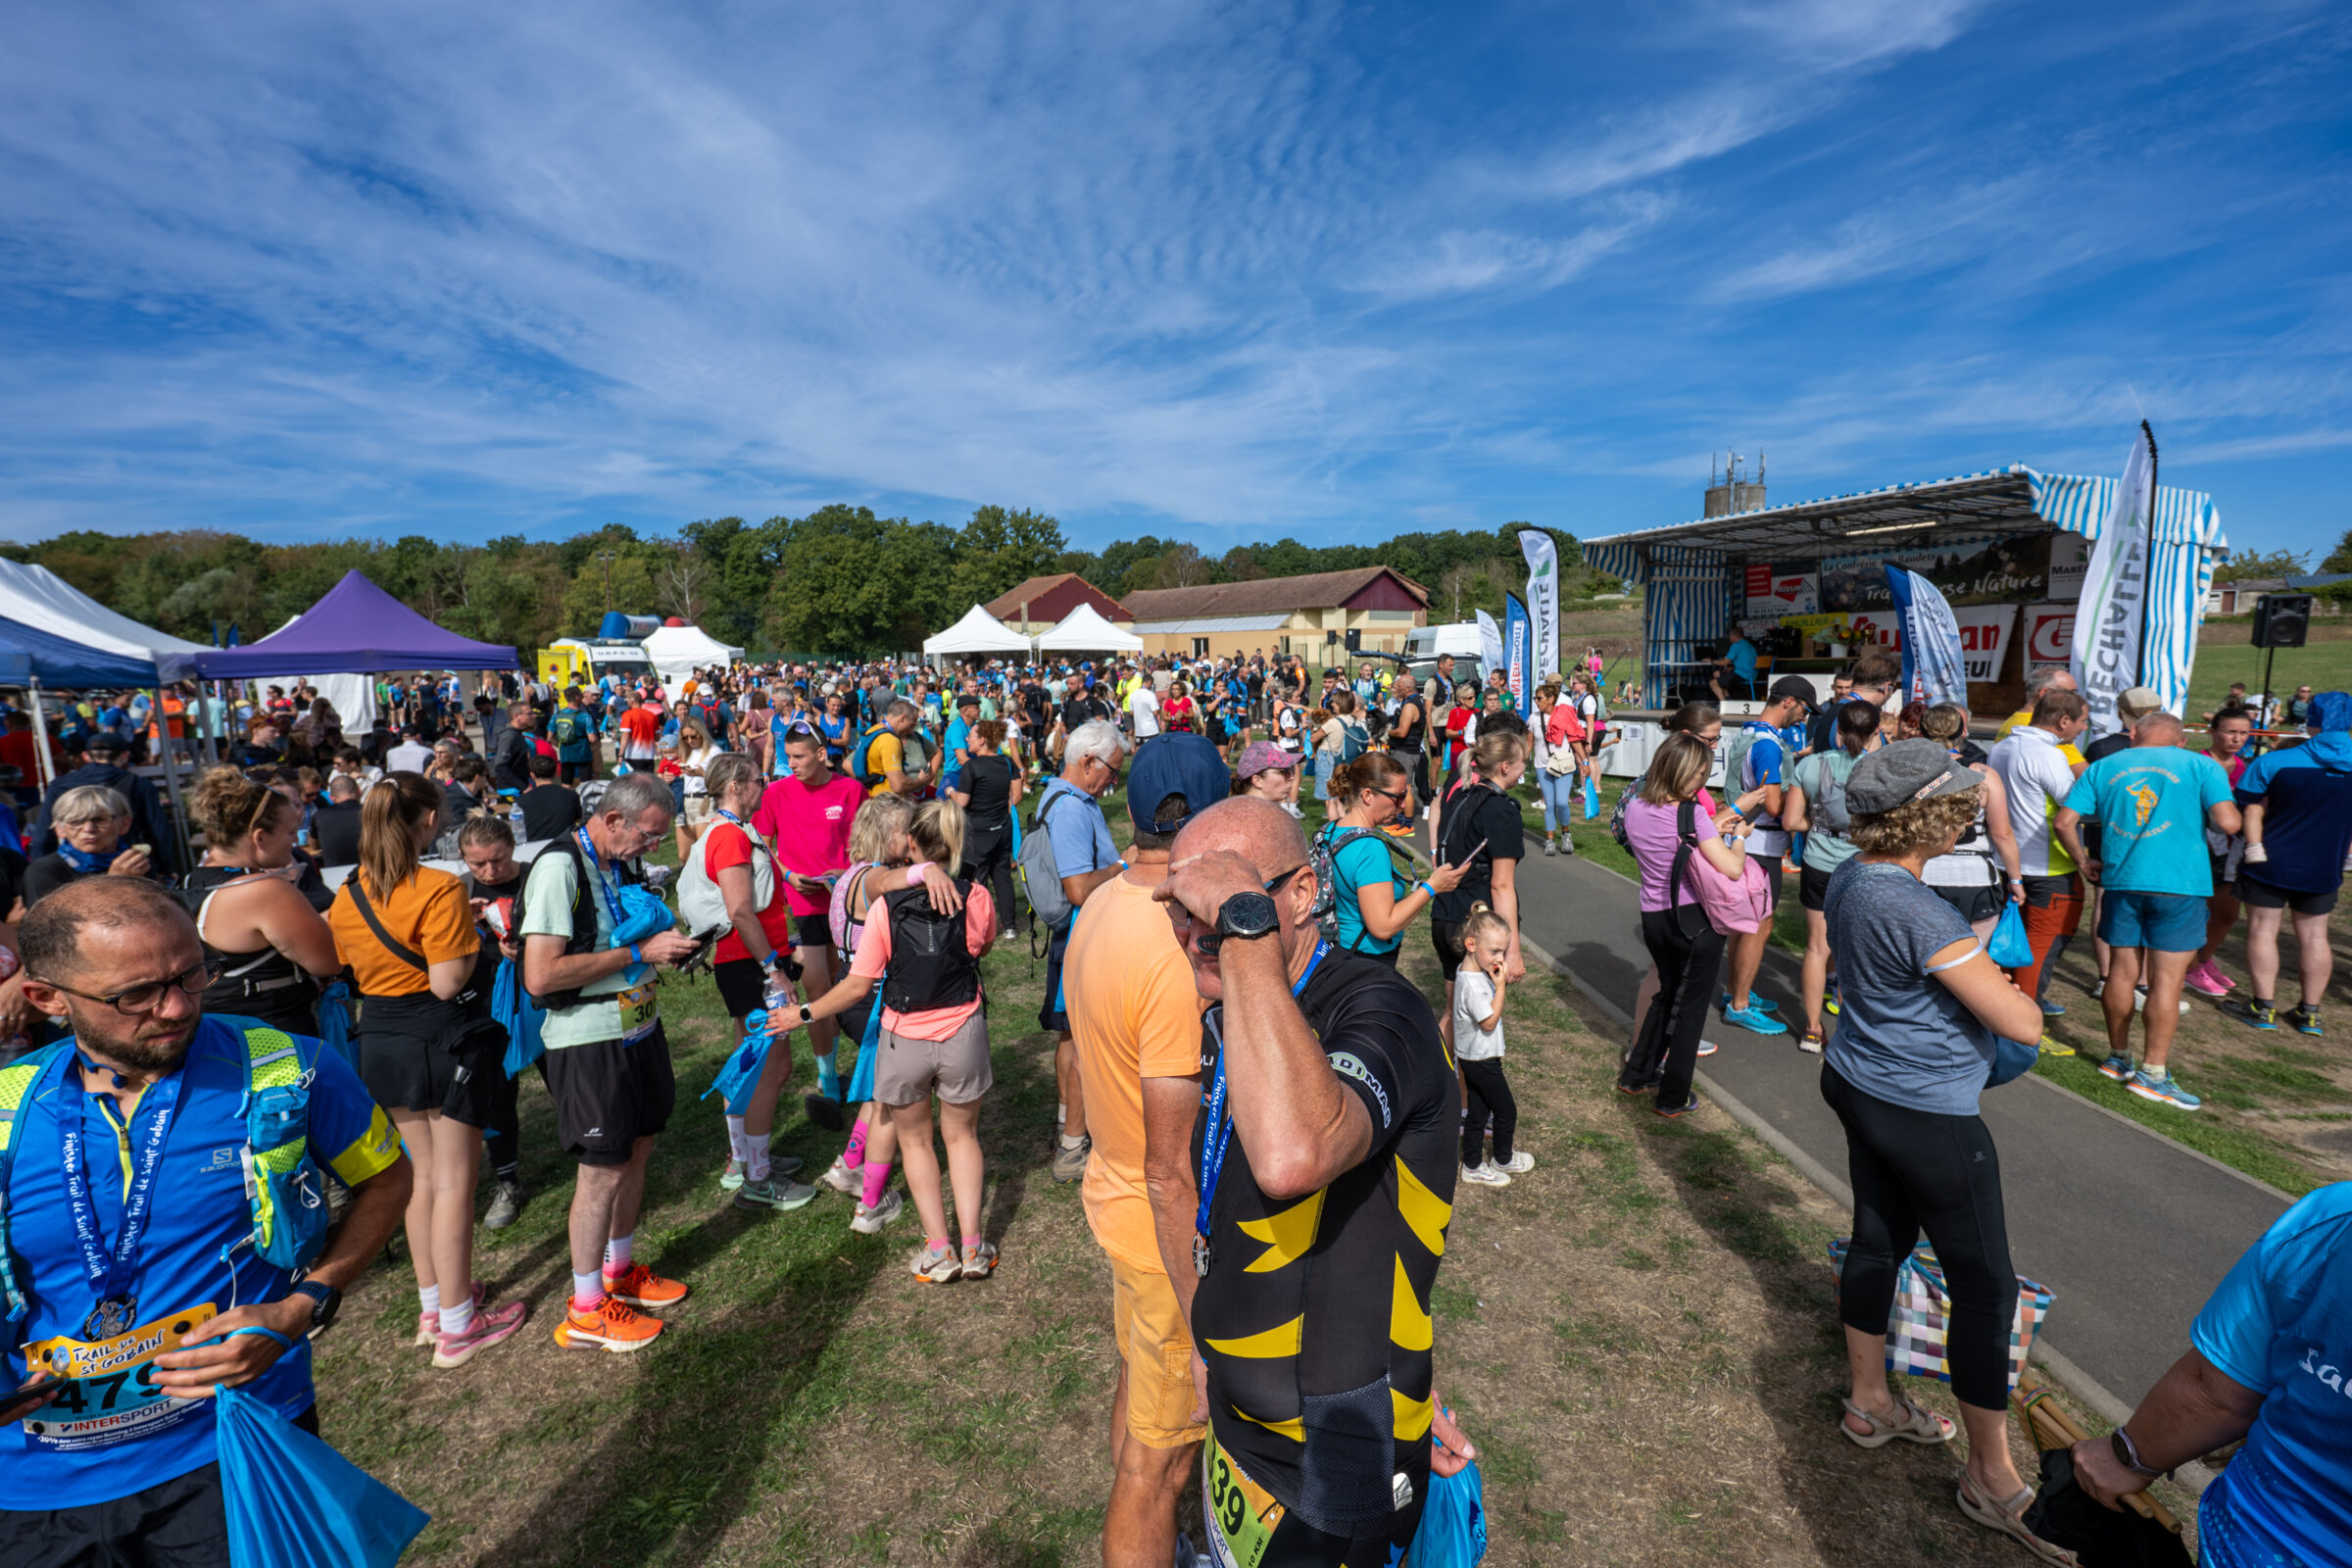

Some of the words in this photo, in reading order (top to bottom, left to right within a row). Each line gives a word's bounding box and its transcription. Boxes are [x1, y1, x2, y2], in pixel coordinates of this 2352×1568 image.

[1974, 572, 2042, 595] Nature
[1743, 704, 1750, 714] 3
[634, 997, 655, 1023] 30
[1211, 1076, 1225, 1117] Finisher
[147, 1107, 172, 1147] Gobain
[1207, 1122, 1217, 1146] Trail
[63, 1131, 78, 1174] Finisher
[69, 1174, 84, 1199] Trail
[135, 1176, 149, 1192] de
[73, 1200, 86, 1213] de
[126, 1192, 145, 1219] Trail
[117, 1221, 139, 1262] Finisher
[83, 1242, 107, 1280] Gobain
[73, 1344, 116, 1362] TRAIL
[101, 1328, 166, 1370] GOBAIN
[74, 1398, 172, 1432] INTERSPORT
[1253, 1536, 1264, 1556] KM
[1249, 1555, 1258, 1568] 10
